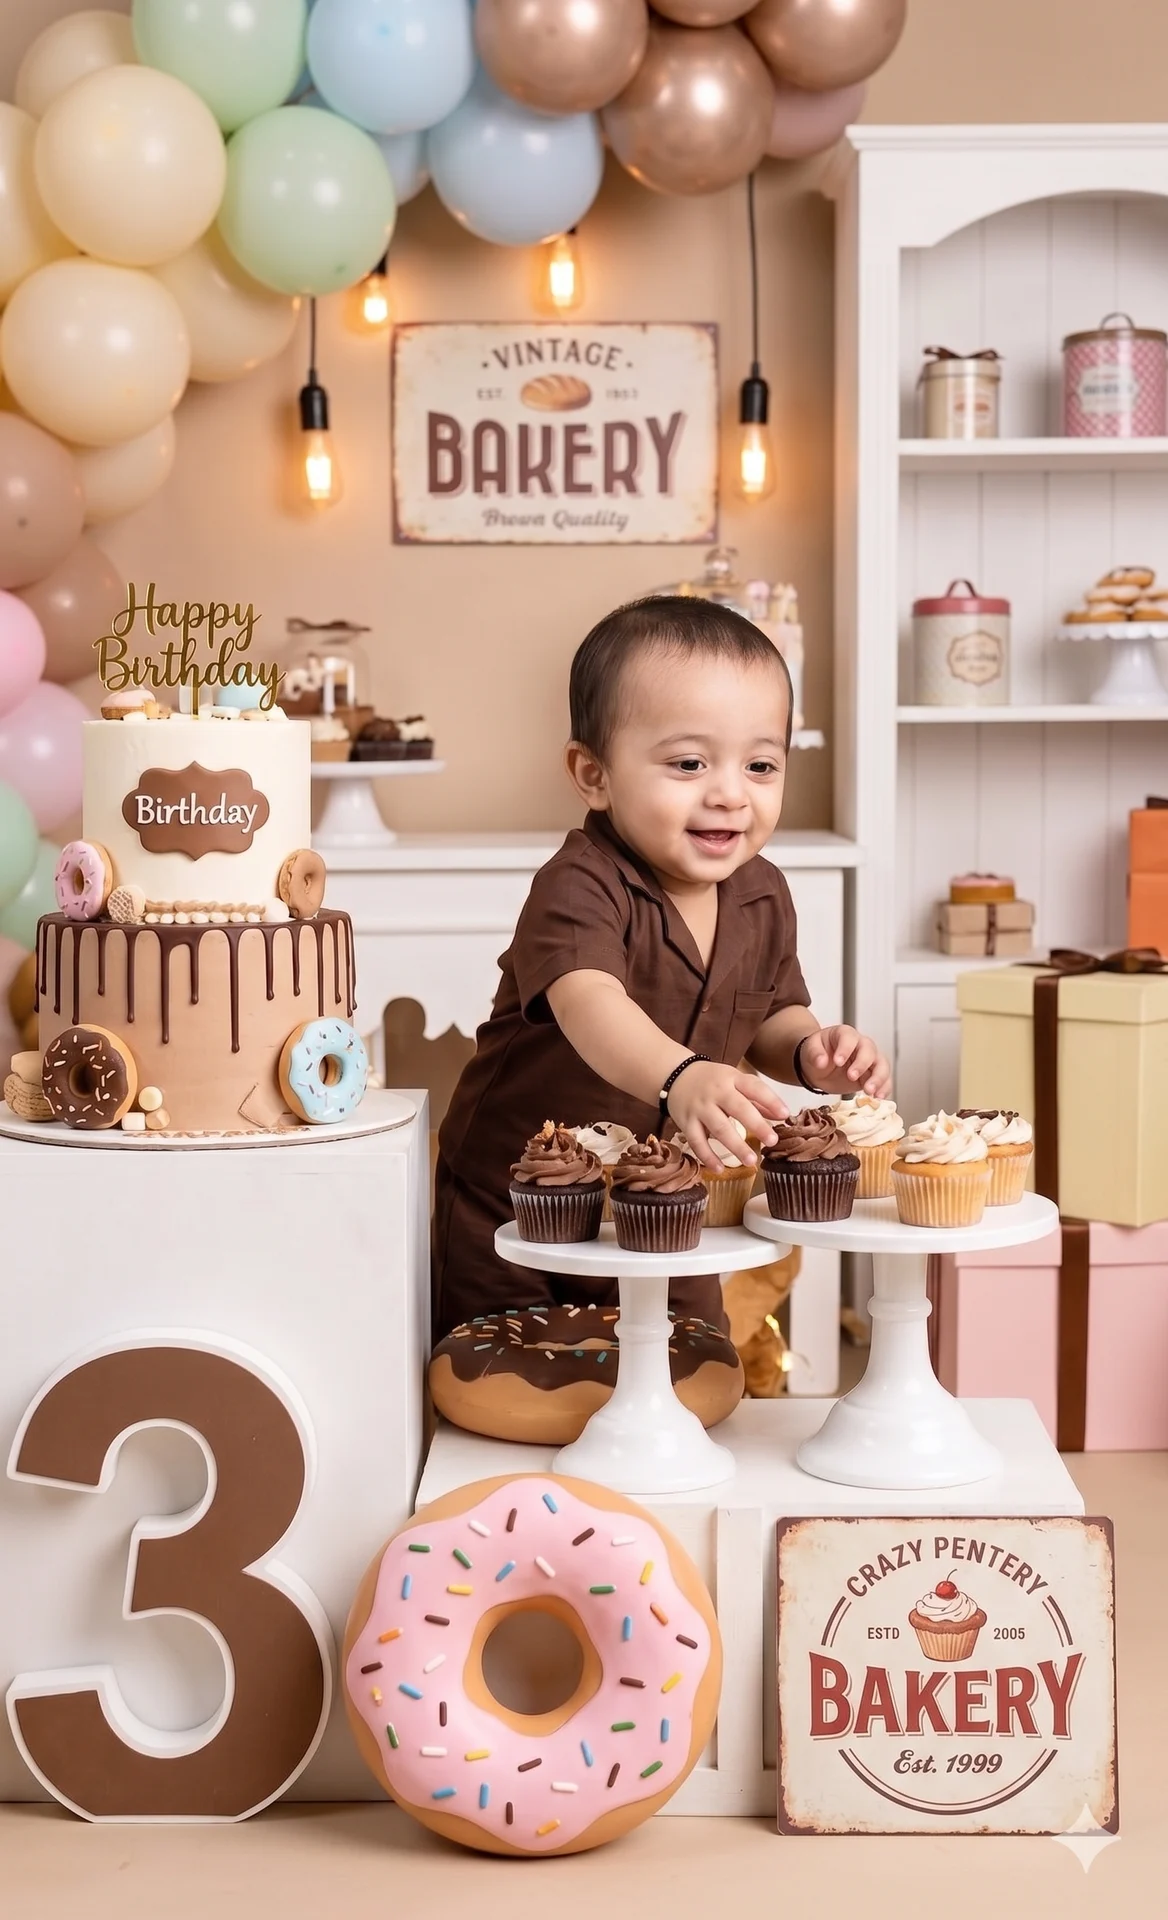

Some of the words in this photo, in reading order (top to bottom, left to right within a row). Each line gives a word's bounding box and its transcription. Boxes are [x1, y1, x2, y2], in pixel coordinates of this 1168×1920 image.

[493, 338, 623, 371] VINTAGE
[427, 410, 688, 498] BAKERY
[552, 508, 629, 533] Quality
[112, 582, 262, 651] Happy
[92, 636, 287, 712] Birthday
[135, 792, 258, 834] Birthday
[6, 1326, 336, 1823] 3
[846, 1538, 922, 1597] CRAZY
[934, 1536, 1049, 1596] PENTERY
[867, 1627, 900, 1640] ESTD
[993, 1627, 1026, 1641] 2005
[808, 1651, 1087, 1740] BAKERY
[893, 1749, 937, 1774] Est.
[946, 1753, 1003, 1774] 1999
